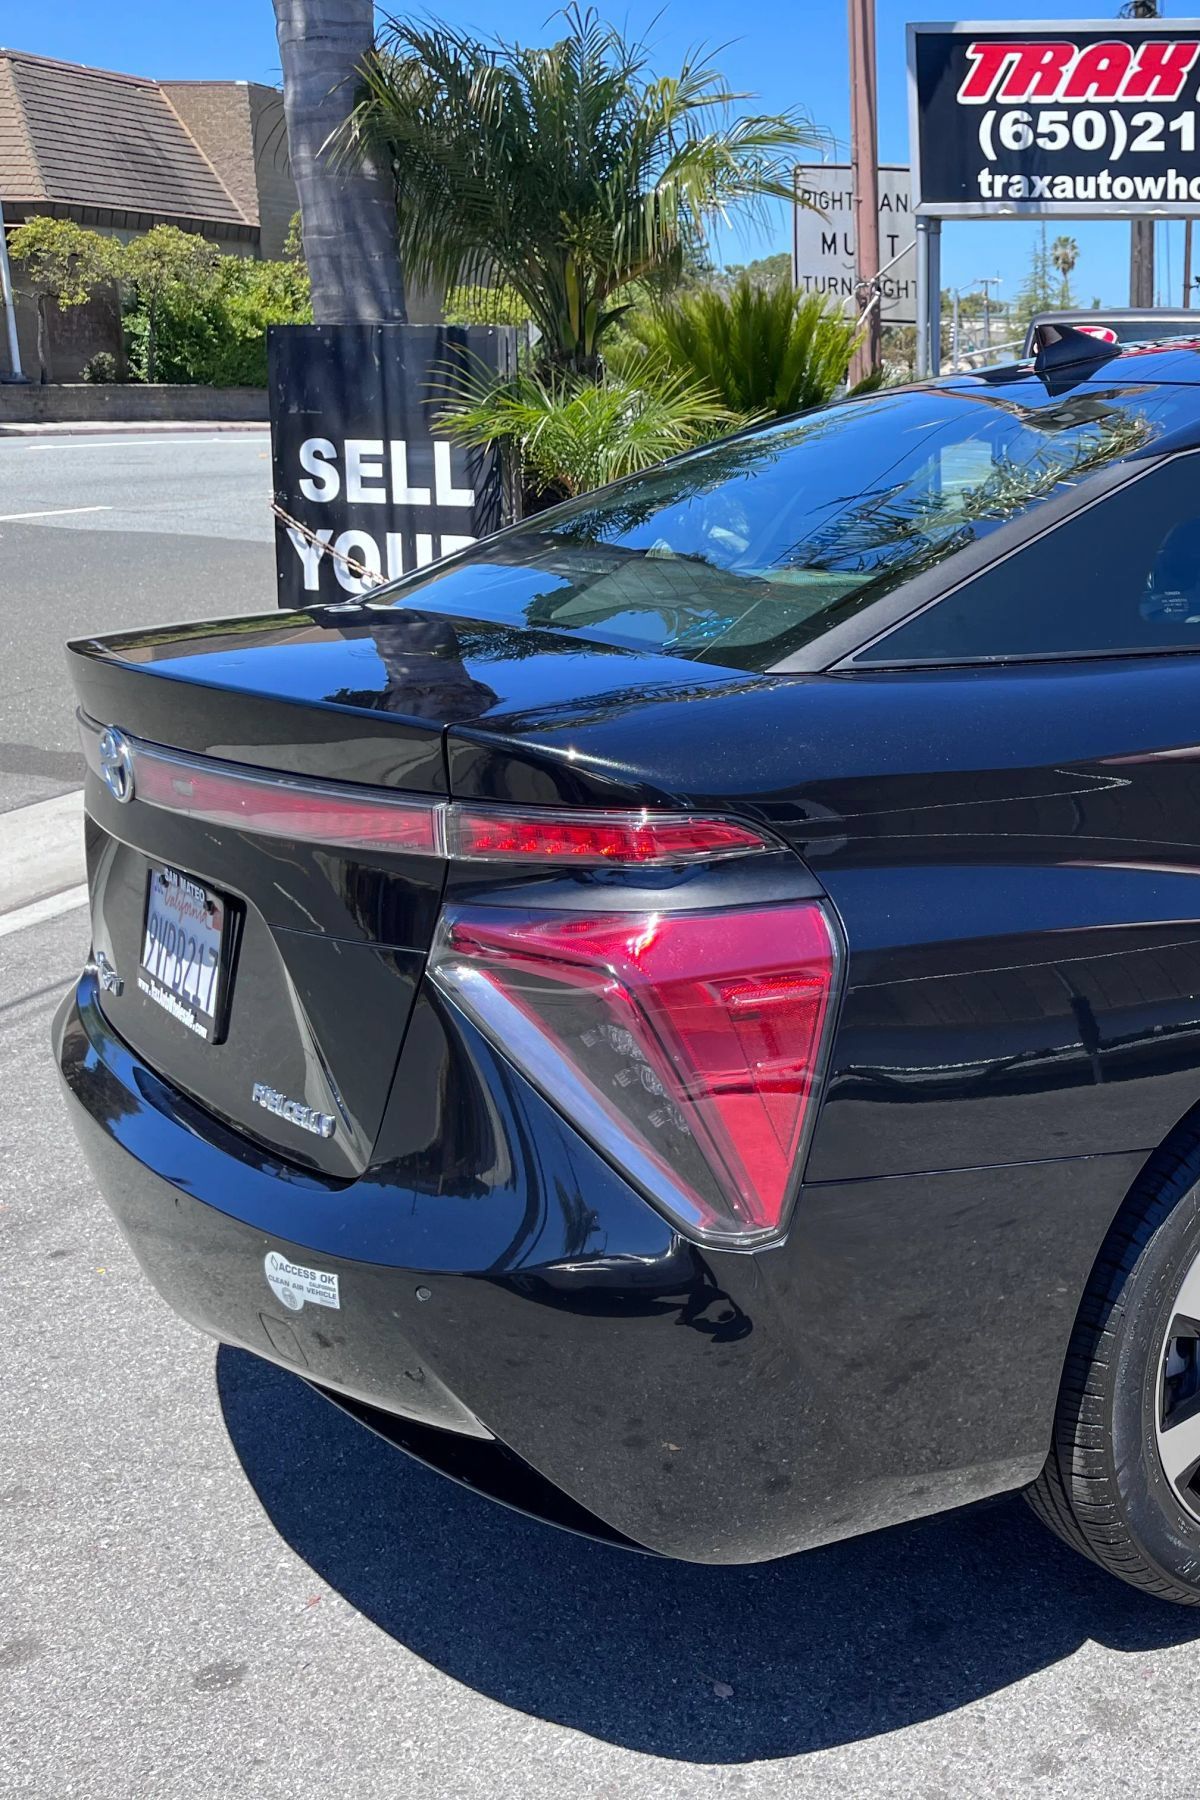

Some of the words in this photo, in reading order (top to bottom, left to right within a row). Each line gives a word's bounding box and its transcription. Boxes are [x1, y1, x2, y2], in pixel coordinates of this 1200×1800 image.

[957, 40, 1200, 104] TRAX
[821, 232, 899, 258] MUT
[803, 275, 852, 296] TURN
[299, 437, 475, 507] SELL
[286, 529, 480, 595] YOU
[164, 867, 179, 888] SAN
[180, 877, 205, 903] MATEO
[144, 911, 219, 1013] 9VPB217
[268, 1274, 290, 1287] CLEAN
[292, 1282, 305, 1293] AIR
[306, 1287, 337, 1300] VEHICLE
[279, 1262, 317, 1281] ACCESS
[320, 1274, 335, 1285] OK
